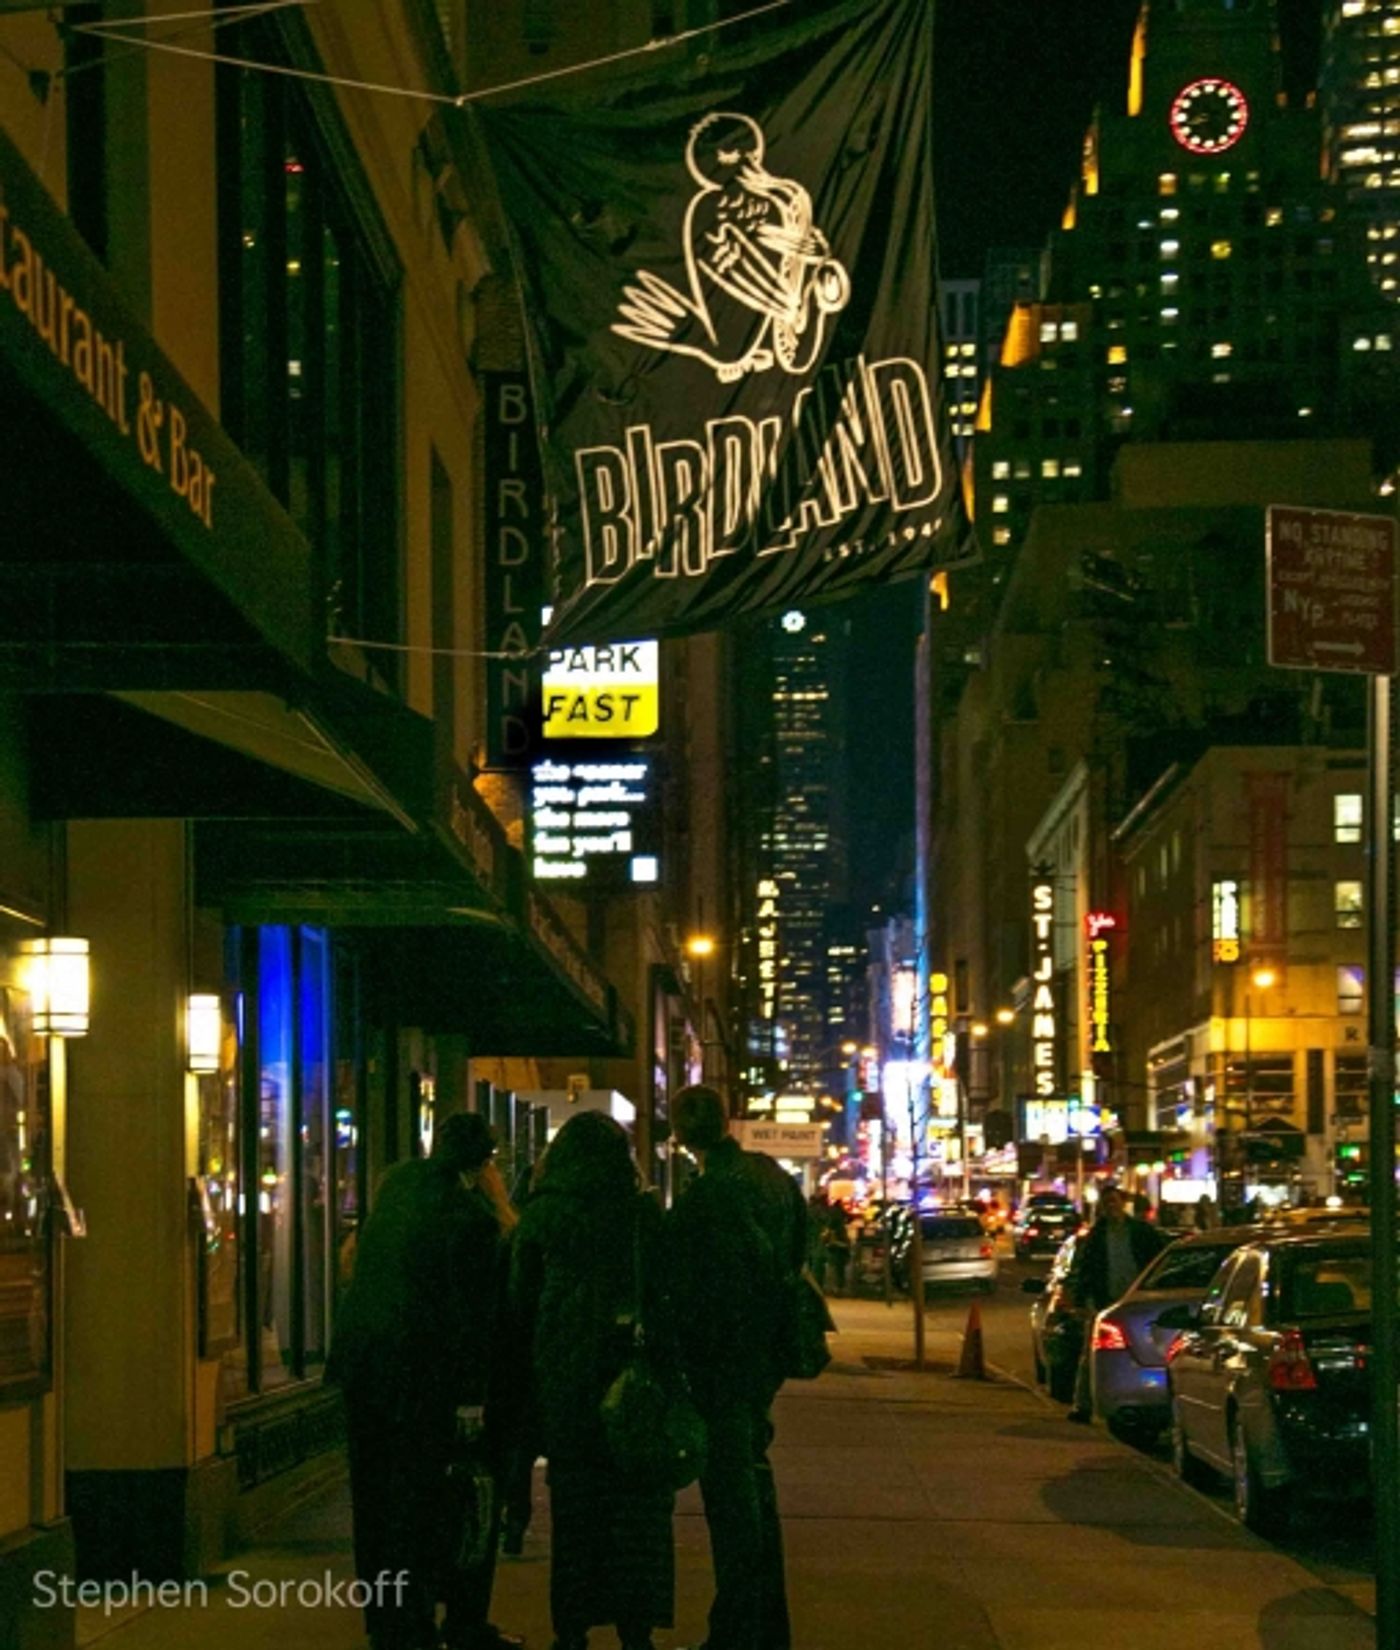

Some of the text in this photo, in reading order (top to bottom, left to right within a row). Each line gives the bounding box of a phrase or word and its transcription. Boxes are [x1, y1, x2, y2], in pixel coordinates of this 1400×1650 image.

[137, 371, 163, 474] &
[170, 403, 215, 530] Bar
[576, 355, 942, 585] BIRDLAND
[498, 384, 530, 755] BIRDLAND
[546, 694, 641, 723] FAST
[549, 646, 642, 673] PARK
